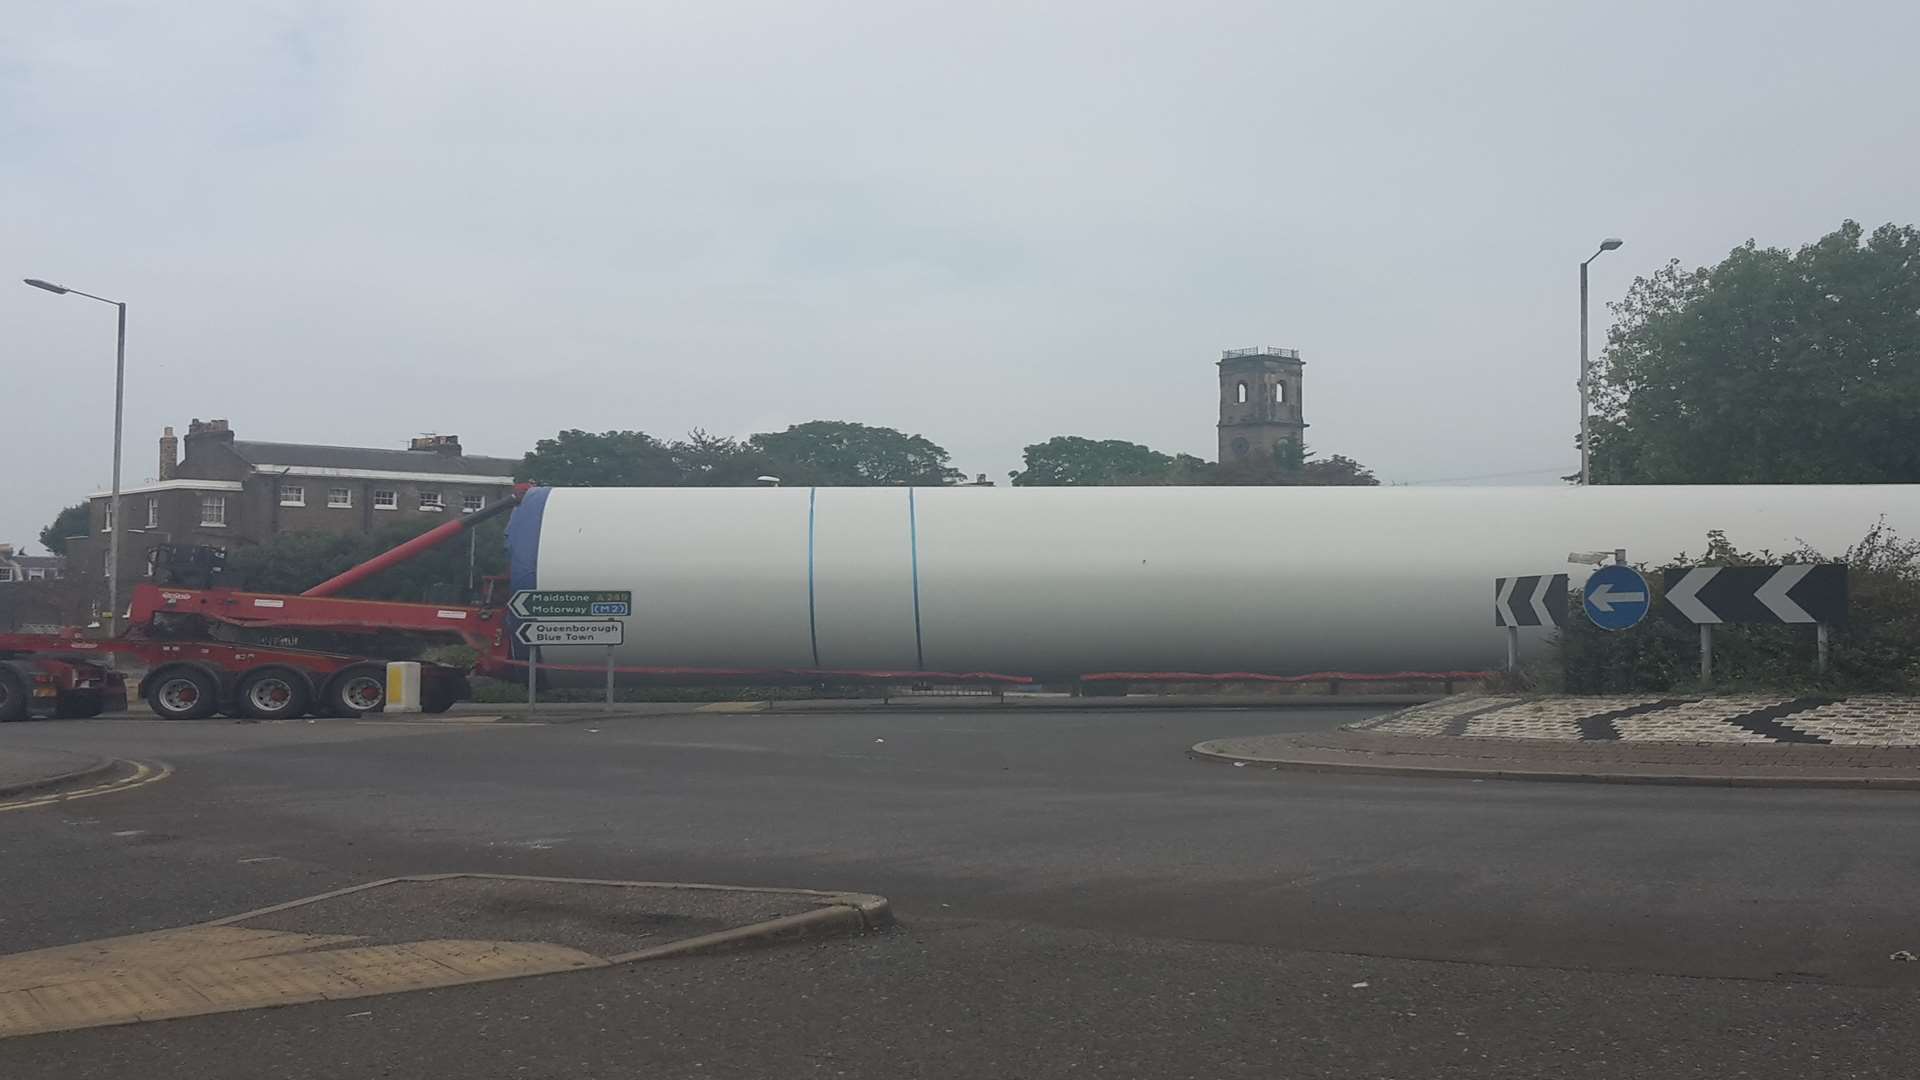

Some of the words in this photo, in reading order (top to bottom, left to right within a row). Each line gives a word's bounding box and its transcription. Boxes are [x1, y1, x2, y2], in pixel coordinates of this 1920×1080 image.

[532, 594, 590, 602] Maidstone
[532, 606, 587, 615] Motorway
[536, 625, 618, 633] Queenborough
[536, 633, 562, 641] Blue
[566, 633, 594, 641] Town
